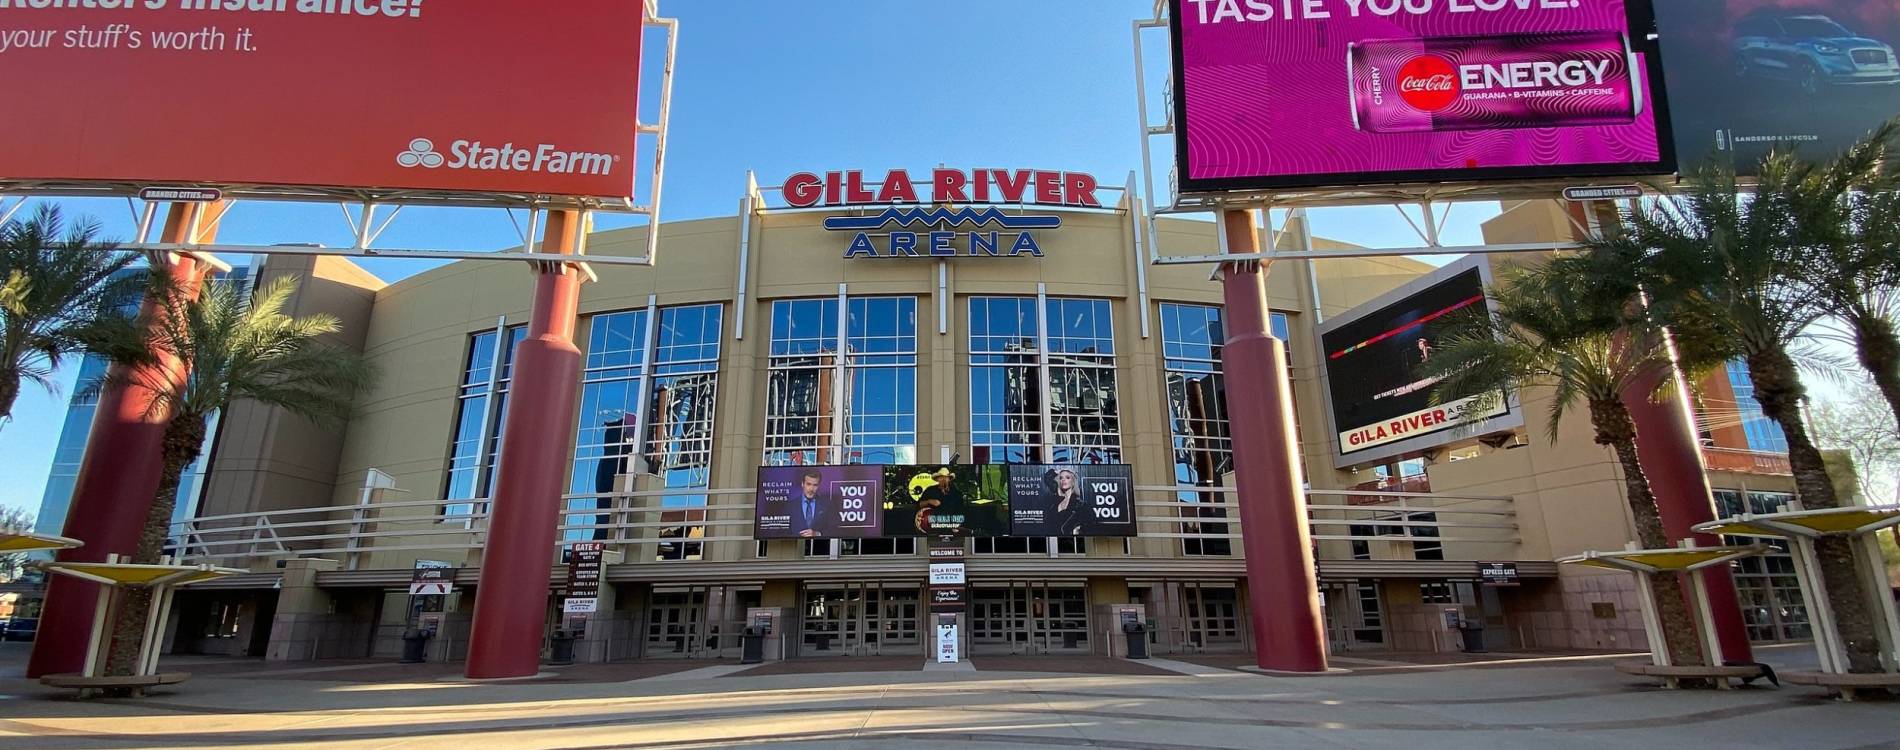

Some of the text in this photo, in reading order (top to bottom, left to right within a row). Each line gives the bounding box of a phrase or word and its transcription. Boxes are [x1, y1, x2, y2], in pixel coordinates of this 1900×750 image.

[1188, 0, 1331, 24] TASTE
[0, 23, 257, 51] your stuff's worth it.
[1459, 59, 1610, 90] ENERGY
[1374, 66, 1383, 105] CHERRY
[1400, 74, 1454, 93] Coca-Cola
[1462, 87, 1614, 100] GUARANA B-VITAMINS CAFFEINE
[145, 190, 178, 198] BRANDED
[782, 168, 1102, 208] GILA RIVER
[843, 230, 1044, 258] ARENA
[1348, 426, 1388, 446] GILA
[1390, 408, 1447, 436] RIVER
[840, 486, 867, 496] YOU
[1091, 482, 1118, 493] YOU
[842, 499, 863, 509] DO
[1096, 494, 1116, 505] DO
[839, 511, 866, 522] YOU
[1093, 507, 1120, 518] YOU
[575, 543, 600, 551] GATE 4
